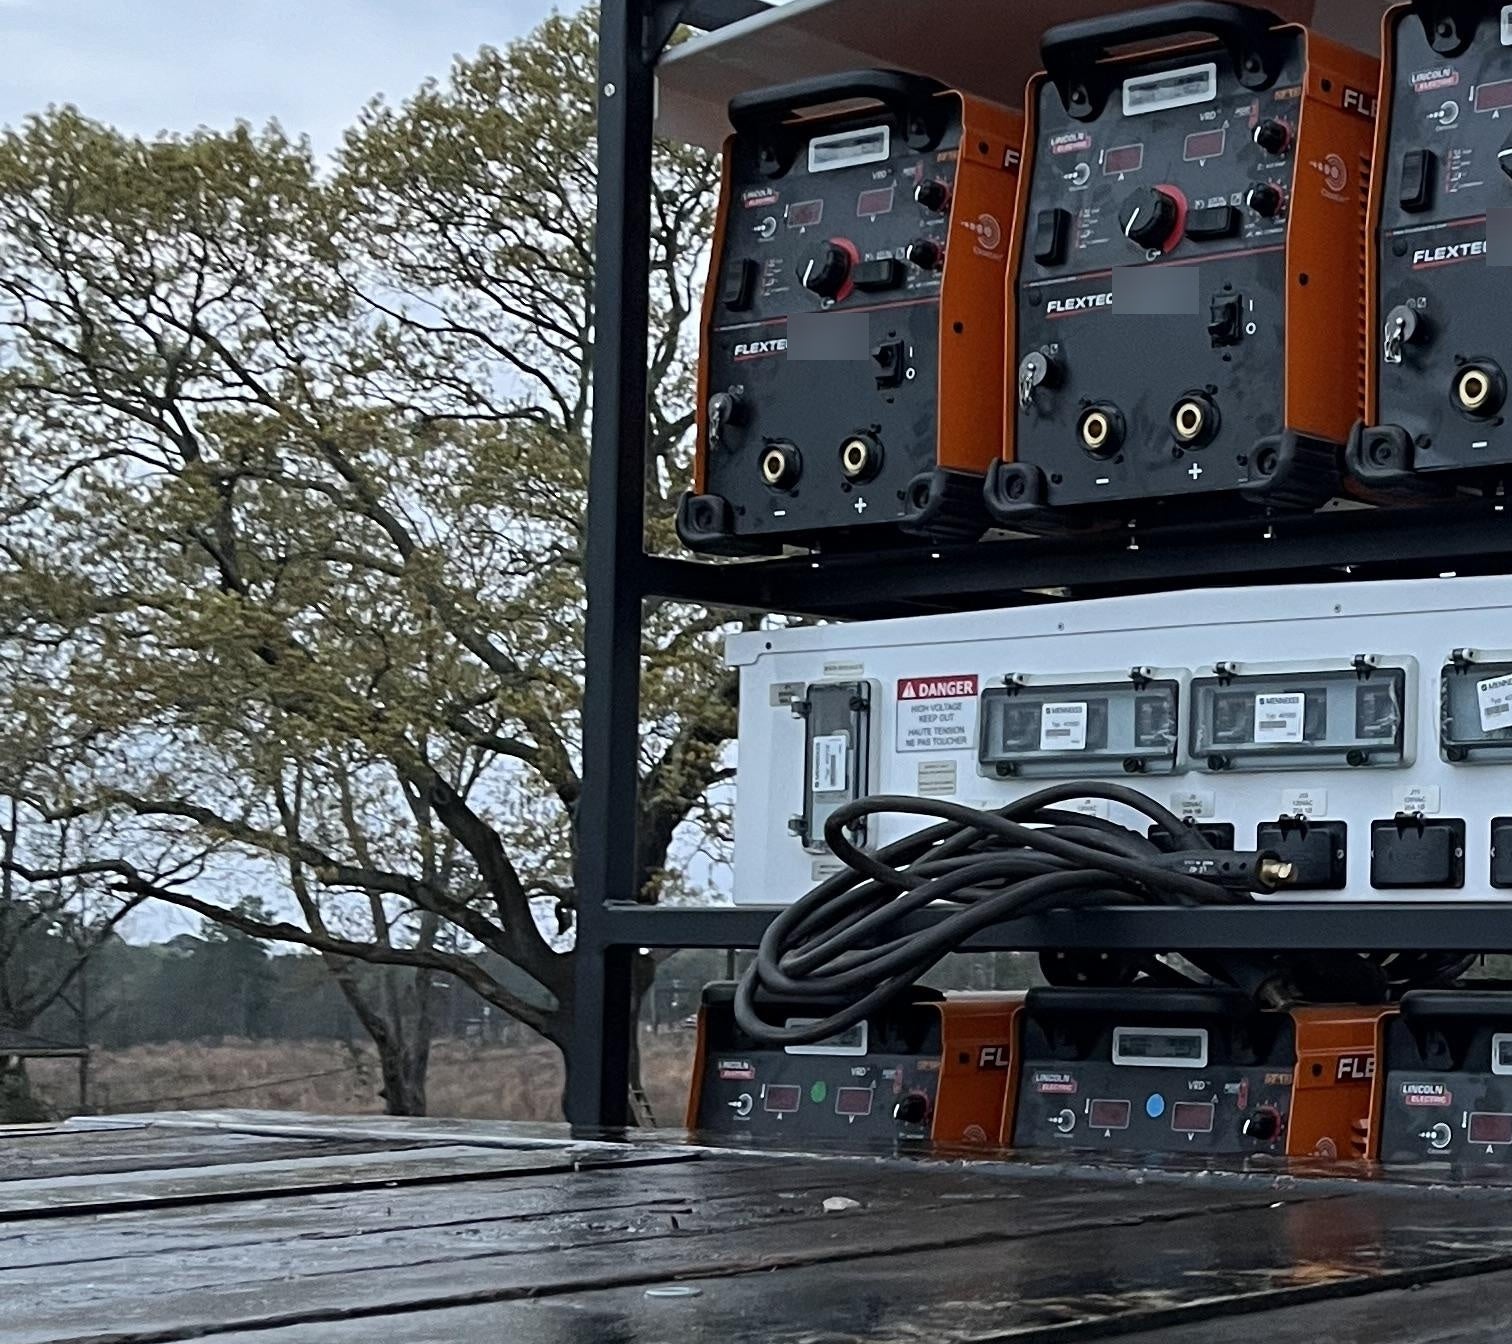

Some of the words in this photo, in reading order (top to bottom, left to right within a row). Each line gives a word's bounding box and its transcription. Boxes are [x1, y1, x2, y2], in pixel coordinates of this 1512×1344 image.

[1413, 240, 1486, 264] FLEXTE
[734, 338, 787, 356] FLEXTE
[919, 681, 973, 697] DANGER
[911, 705, 929, 713] HIGH
[930, 702, 962, 712] VOLTAGE
[919, 714, 937, 723] KEEP
[939, 713, 954, 722] OUT
[933, 726, 965, 735] TENSION
[1035, 1074, 1070, 1082] LINCOLN
[1402, 1084, 1444, 1094] LINCOLN
